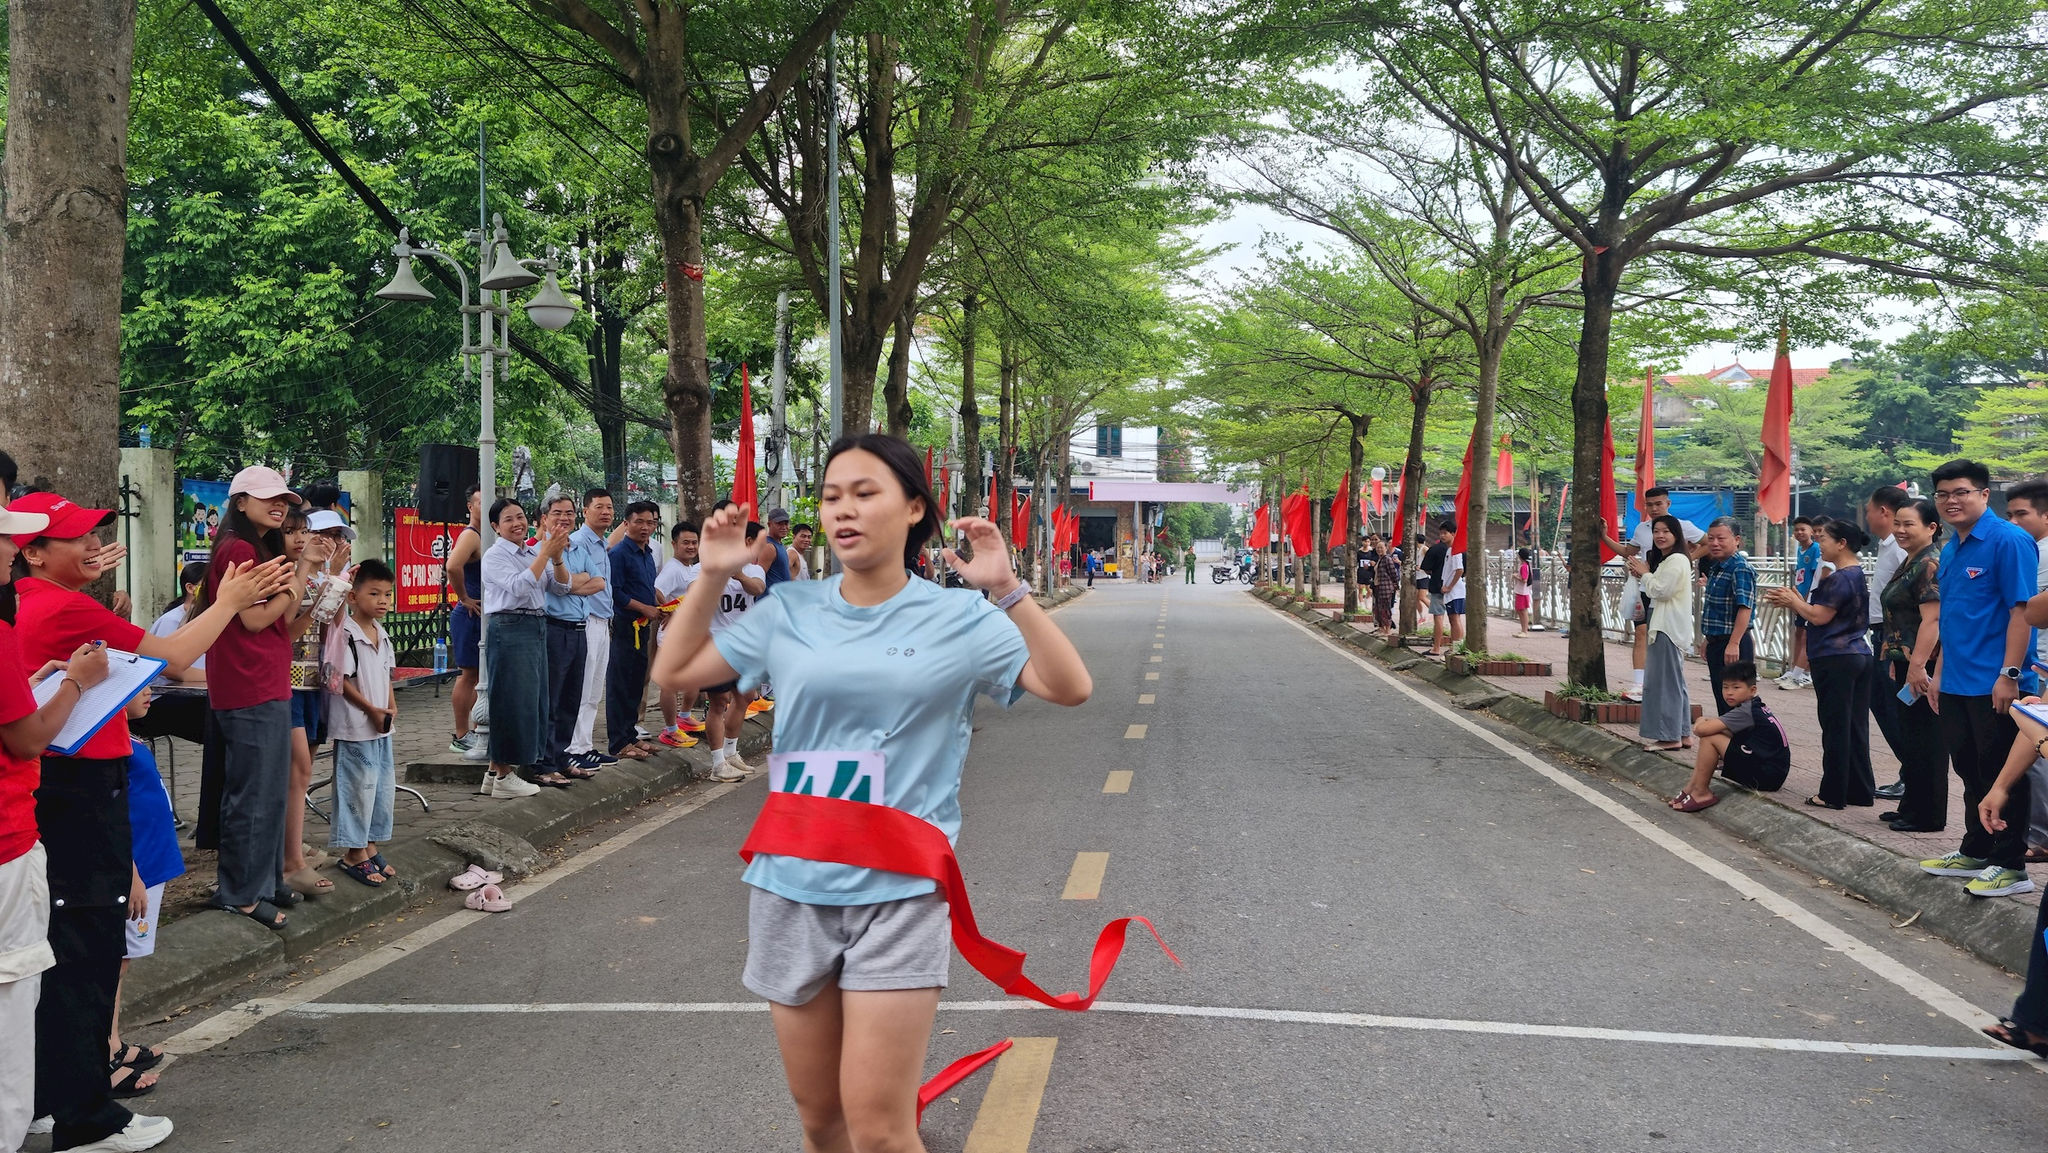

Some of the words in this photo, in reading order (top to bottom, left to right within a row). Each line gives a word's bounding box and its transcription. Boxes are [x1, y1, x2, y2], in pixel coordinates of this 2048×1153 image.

[402, 564, 412, 587] GC
[412, 564, 427, 587] PRO
[720, 593, 748, 613] 04
